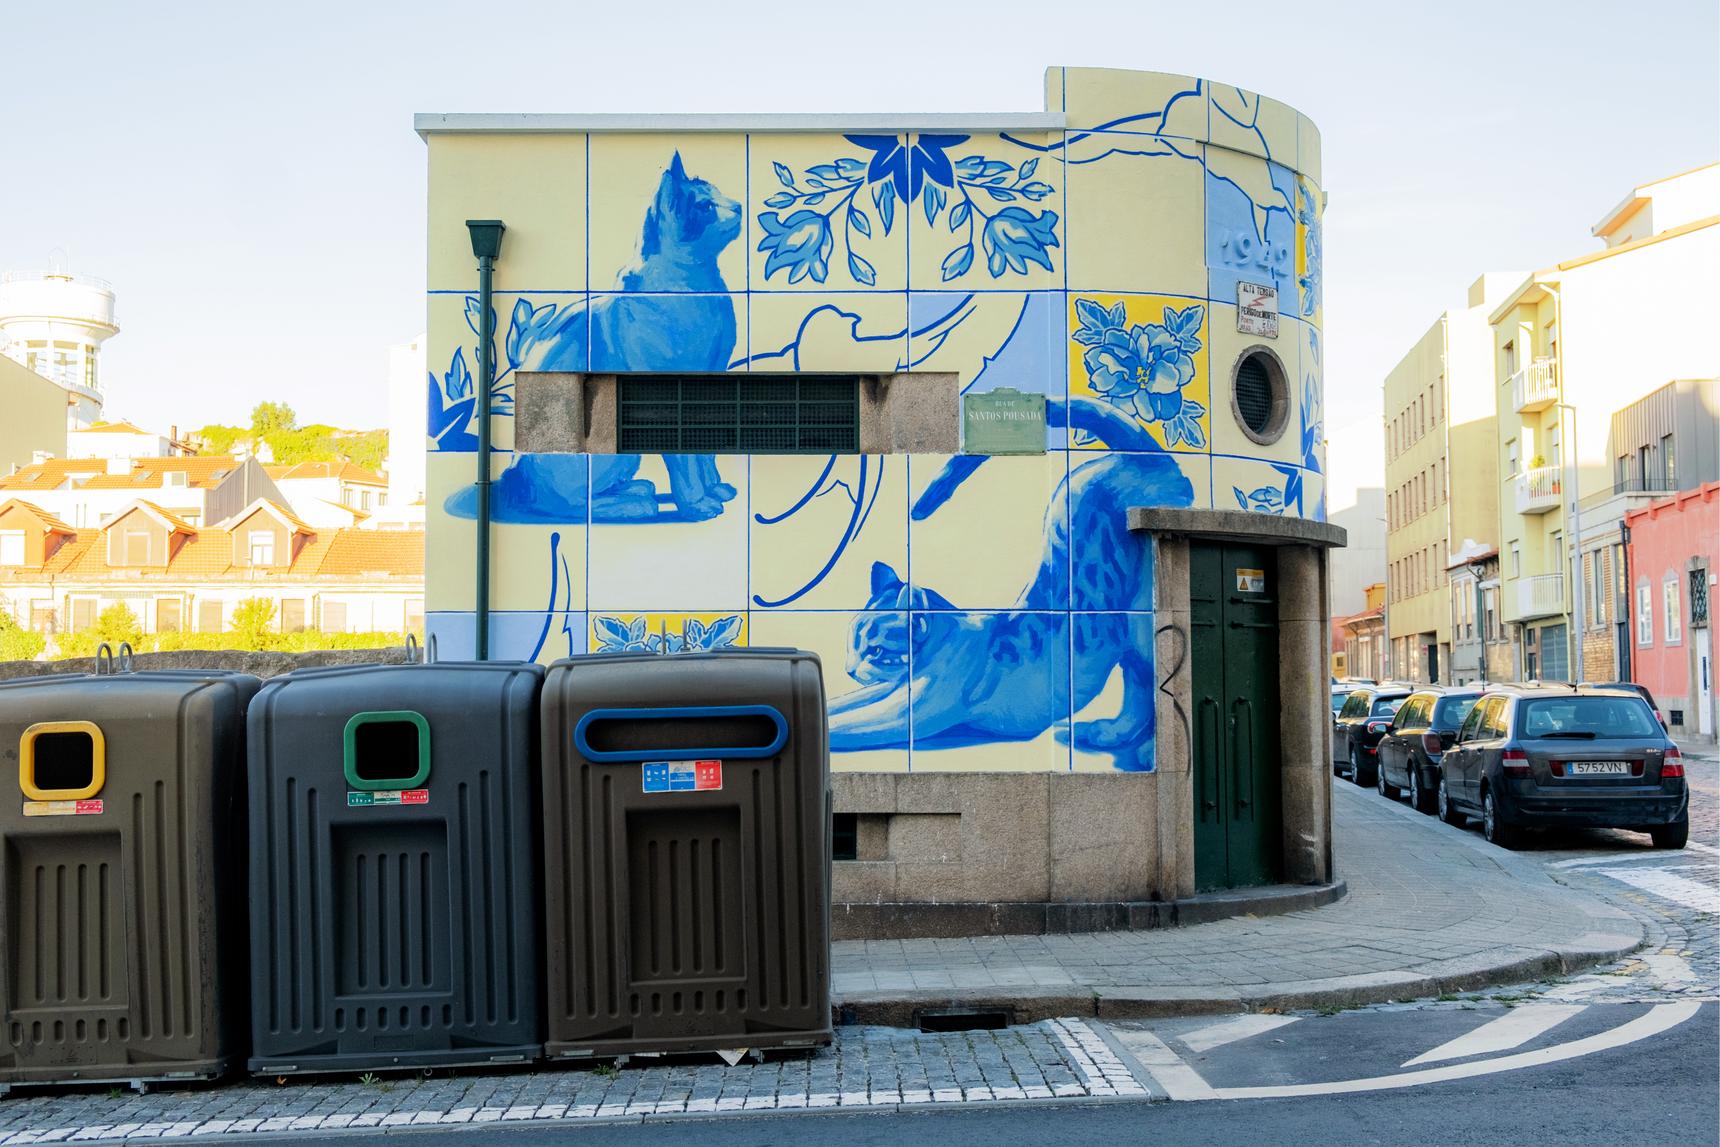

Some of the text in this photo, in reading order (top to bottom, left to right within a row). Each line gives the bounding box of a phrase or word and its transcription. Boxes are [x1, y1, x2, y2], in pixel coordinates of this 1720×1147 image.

[1243, 283, 1254, 294] ALTA
[969, 411, 1041, 421] SANTOS POUSADA
